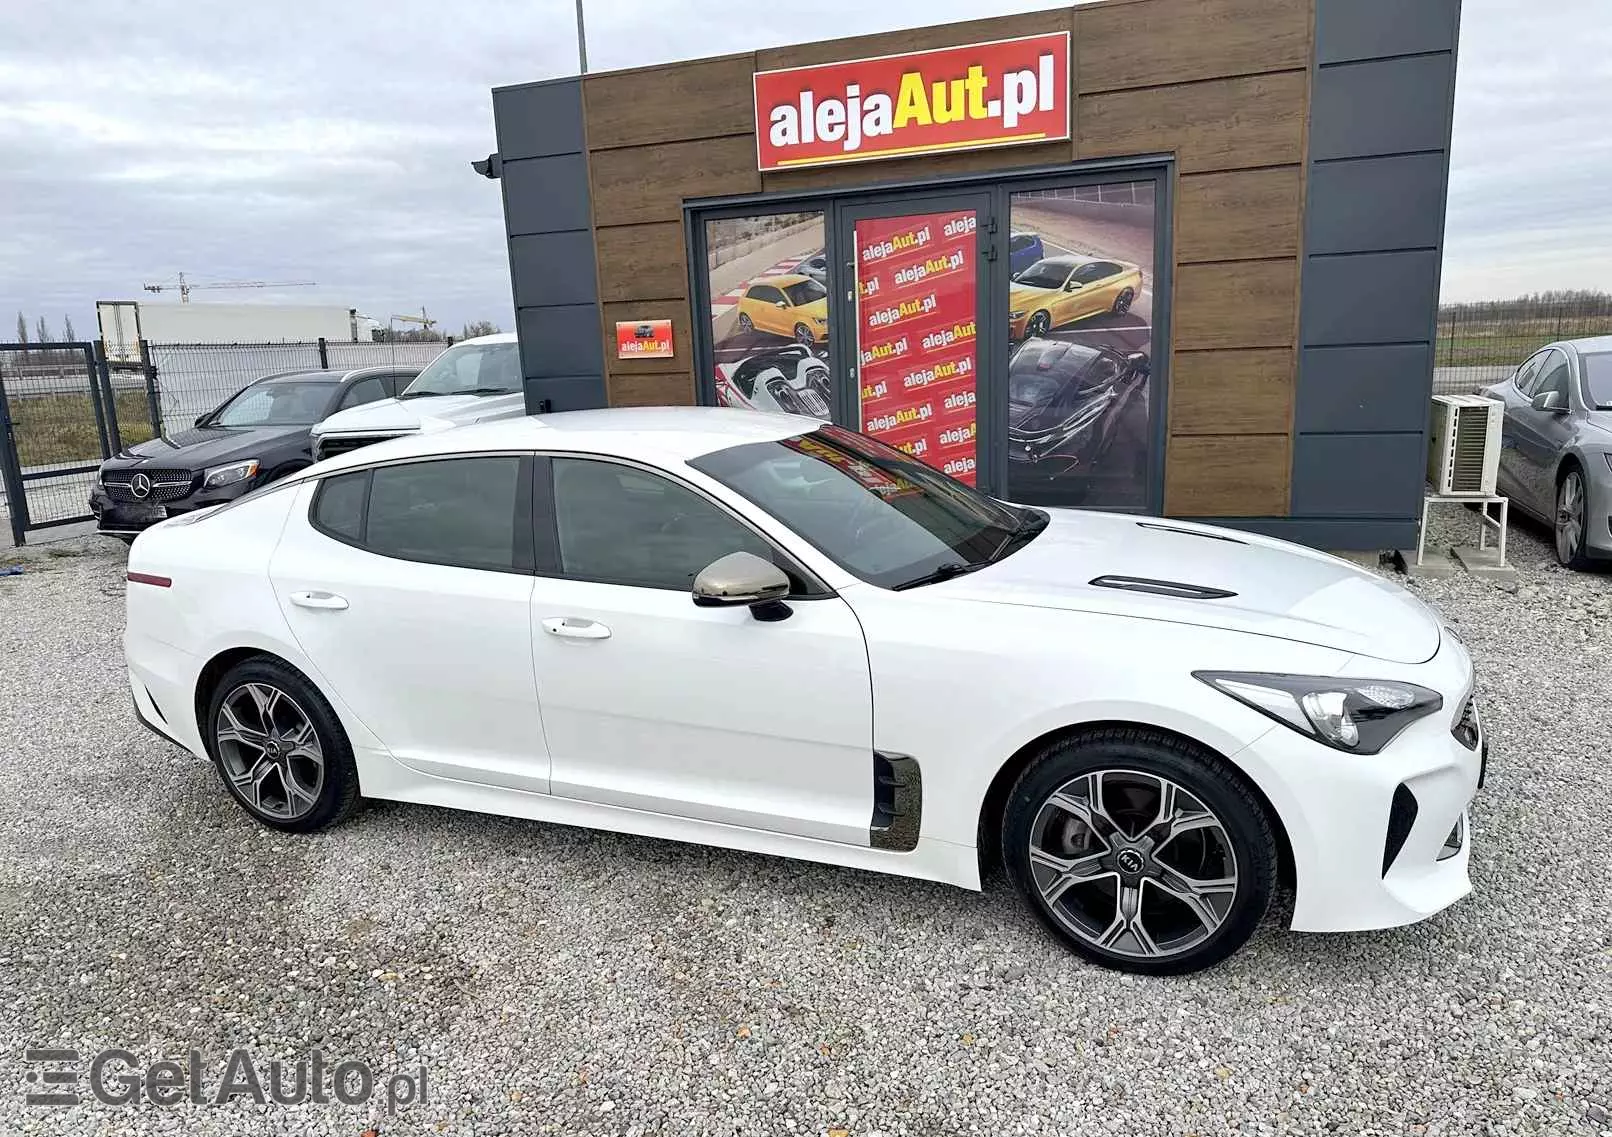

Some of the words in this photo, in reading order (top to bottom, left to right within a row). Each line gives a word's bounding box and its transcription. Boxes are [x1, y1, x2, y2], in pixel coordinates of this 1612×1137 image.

[769, 54, 1054, 151] alejaAut.pl
[862, 227, 930, 260] alejaAut.pl
[894, 250, 964, 284] alejaAut.pl
[869, 294, 937, 326] alejaAut.pl
[621, 340, 670, 352] alejaAut.pl
[903, 357, 971, 387] alejaAut.pl
[944, 391, 976, 408] aleja
[867, 403, 932, 431] alejaAut.pl
[1121, 854, 1138, 871] KIA
